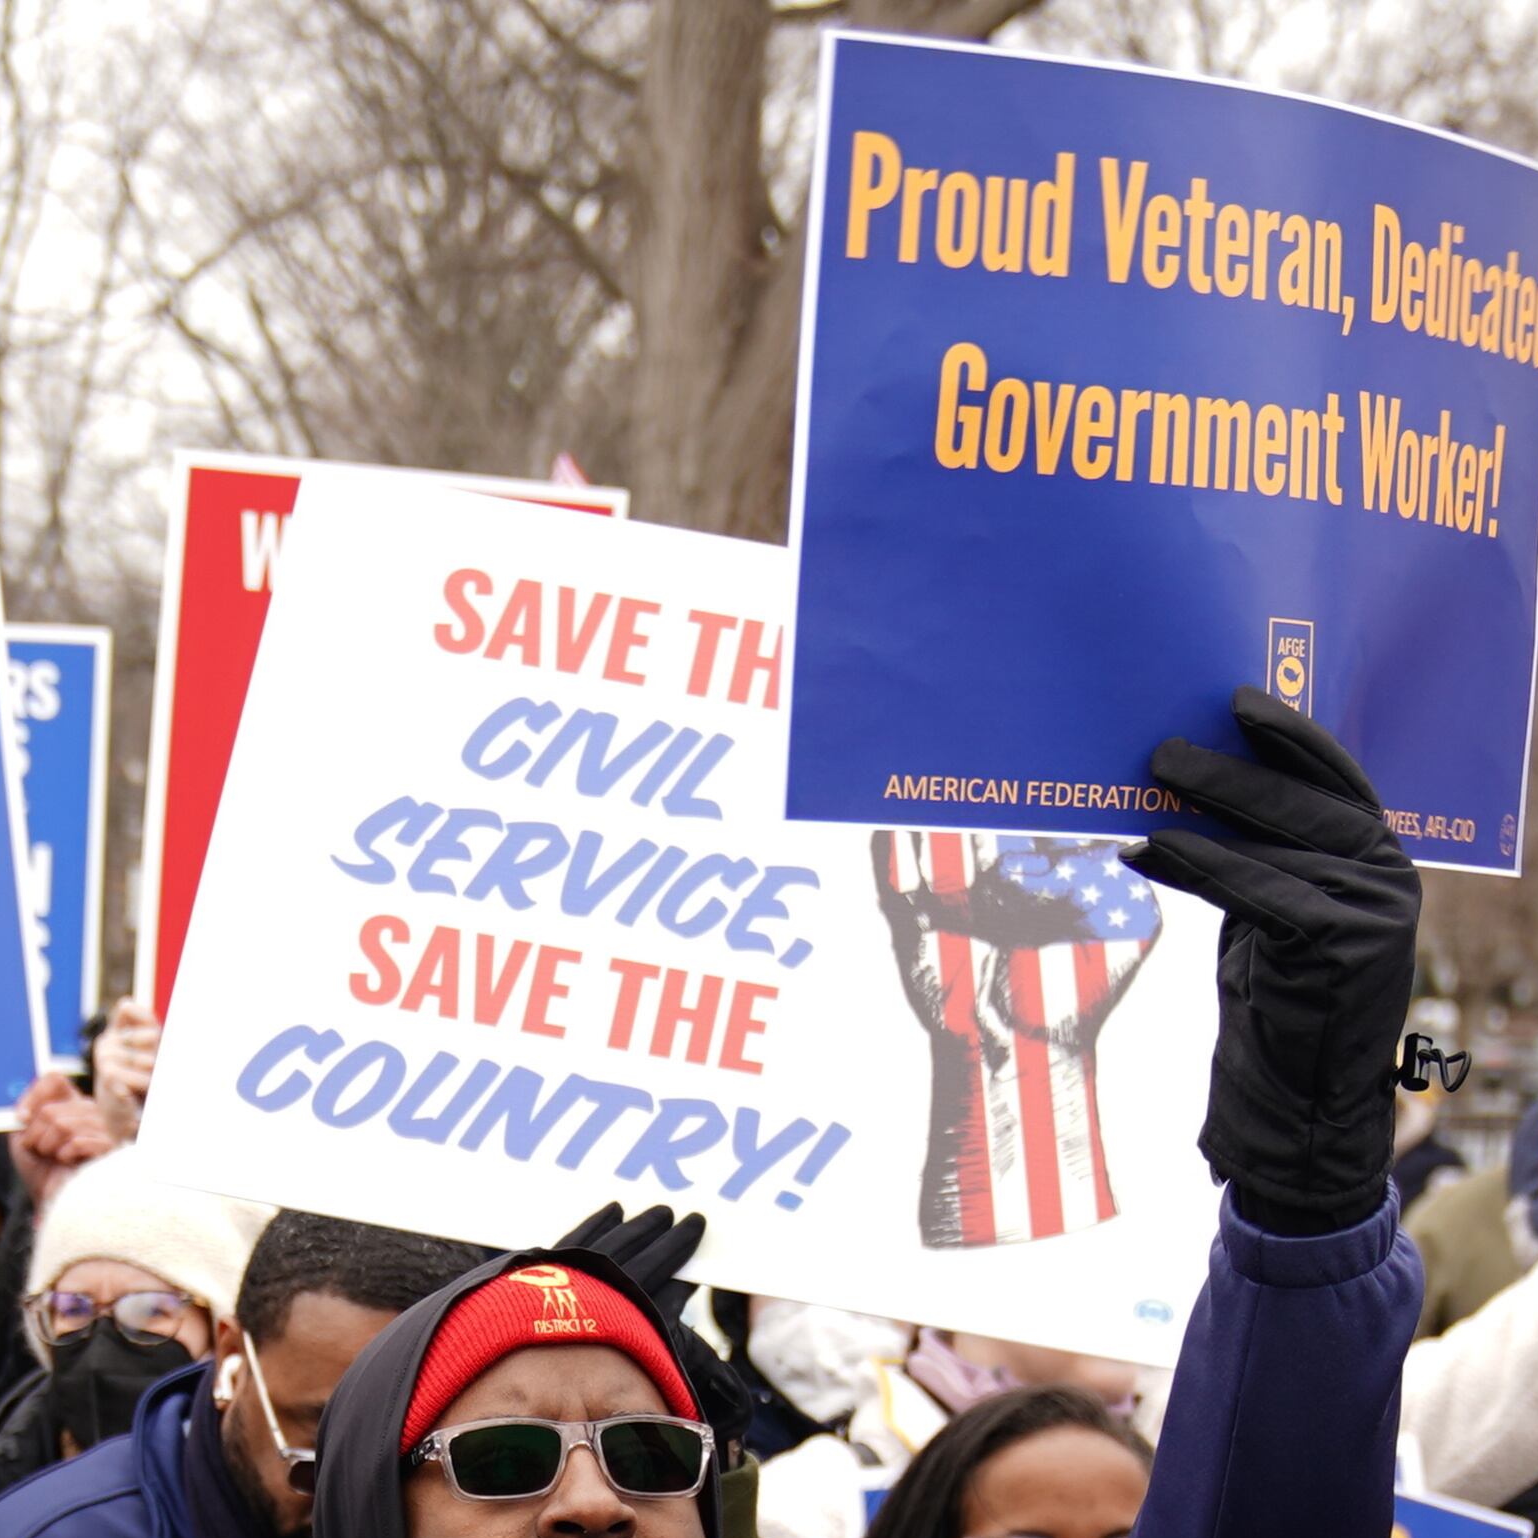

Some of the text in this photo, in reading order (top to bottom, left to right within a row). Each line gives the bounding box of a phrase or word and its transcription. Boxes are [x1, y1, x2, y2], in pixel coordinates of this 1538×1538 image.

[846, 131, 1075, 279] Proud
[1100, 156, 1356, 335] Veteran,
[935, 342, 1505, 539] Government Worker!
[433, 567, 783, 712] SAVE TH
[1277, 637, 1305, 658] AFGE
[460, 696, 735, 822] CIVIL
[884, 774, 1181, 812] AMERICAN FEDERATION
[1382, 809, 1423, 841] OYEES,
[1424, 815, 1476, 843] AFL-CIO
[330, 794, 822, 971] SERVICE,
[348, 913, 779, 1077] SAVE THE
[235, 1023, 852, 1212] COUNTRY!
[534, 1318, 599, 1333] DISTRICT 12
